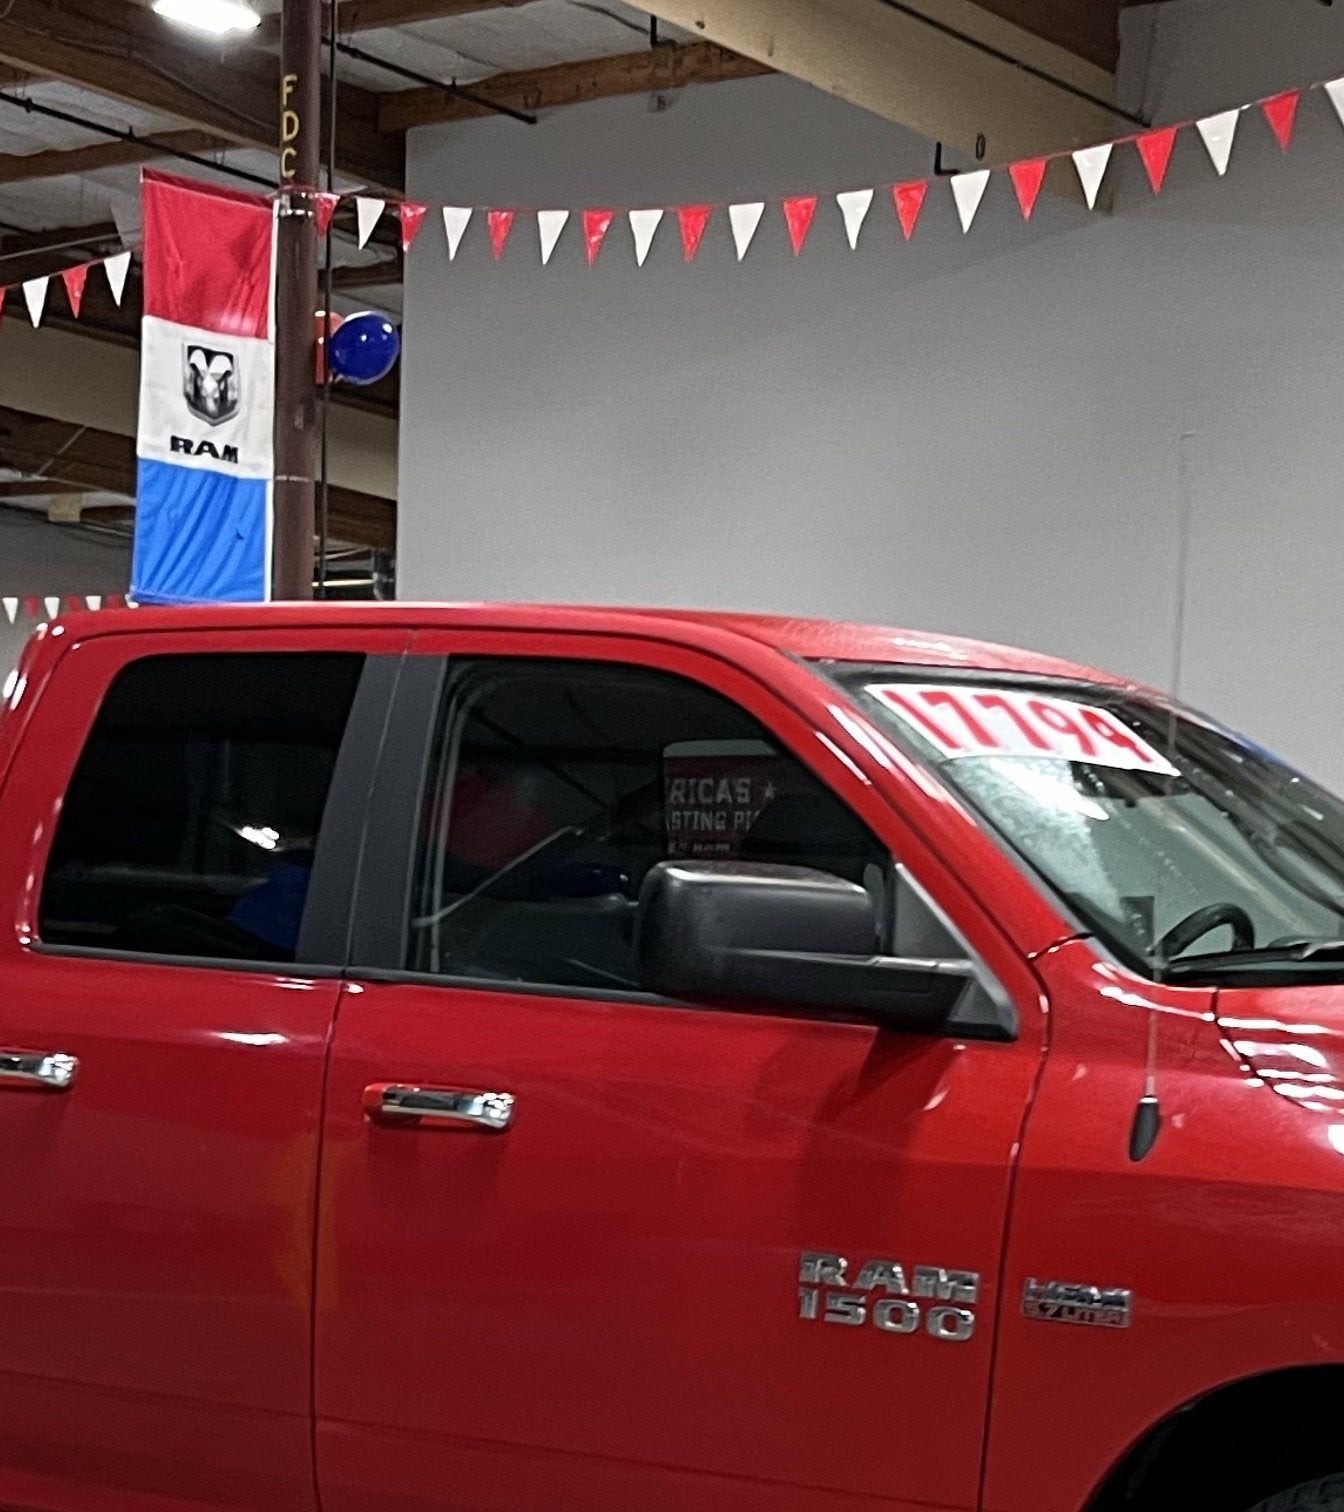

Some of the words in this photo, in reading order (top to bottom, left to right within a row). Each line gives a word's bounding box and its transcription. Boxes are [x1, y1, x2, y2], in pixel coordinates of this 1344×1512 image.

[281, 74, 300, 178] FDC
[169, 435, 239, 464] RAM
[665, 777, 752, 804] RICA'S
[733, 809, 761, 832] PI
[798, 1249, 981, 1304] RAM
[798, 1285, 976, 1342] 1500
